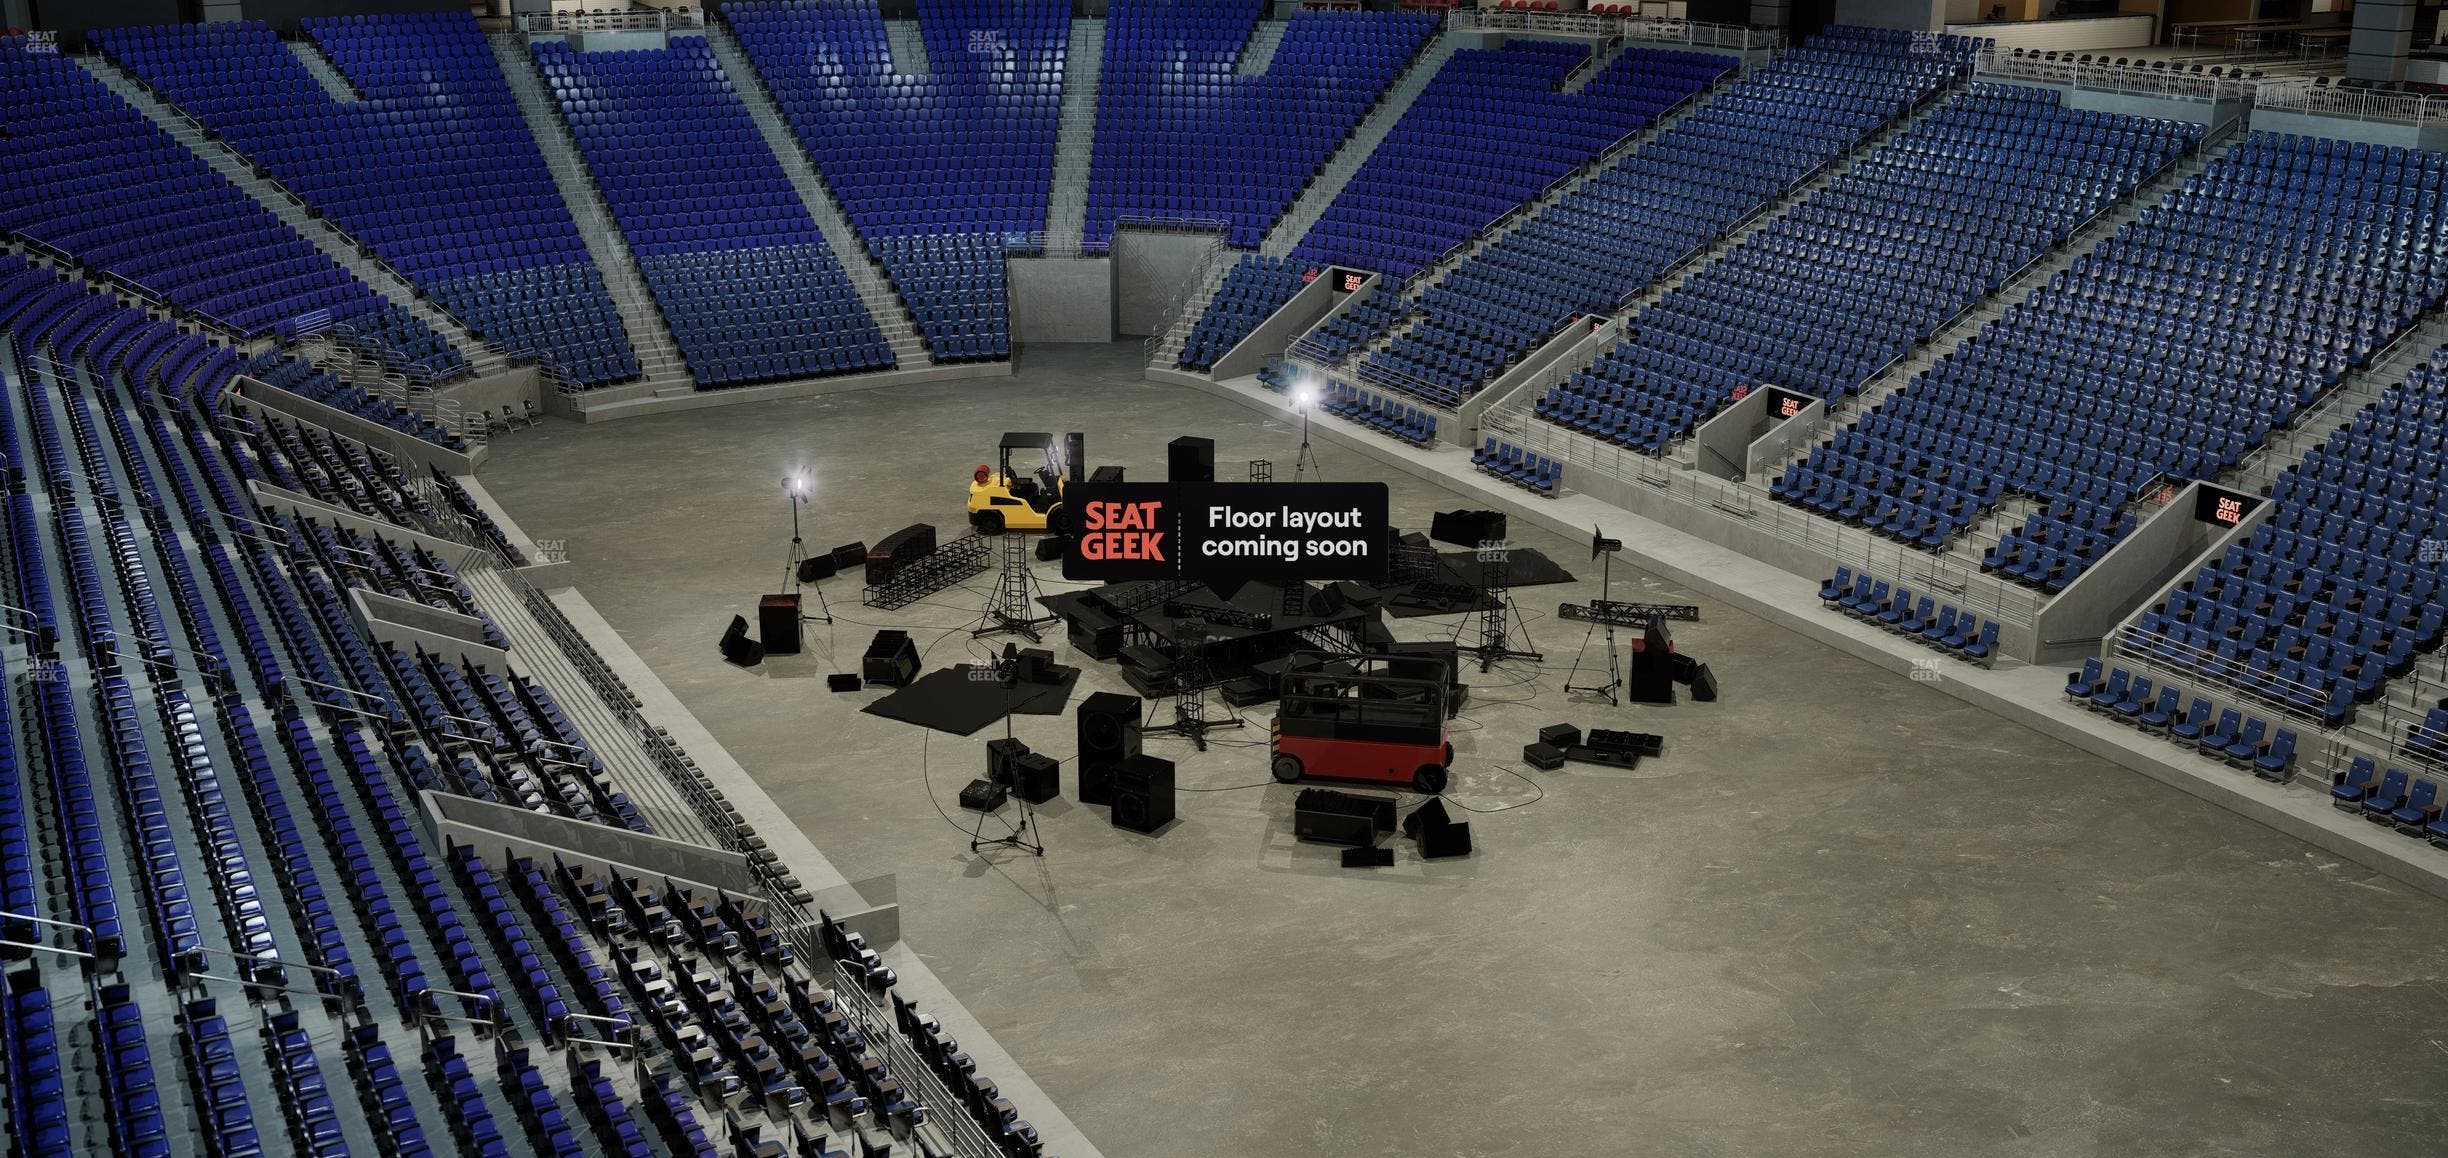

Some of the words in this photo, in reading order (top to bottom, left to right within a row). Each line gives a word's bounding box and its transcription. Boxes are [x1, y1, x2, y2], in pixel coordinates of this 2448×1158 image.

[1345, 274, 1362, 285] SEAT
[1782, 397, 1800, 409] SEAT
[2218, 497, 2242, 513] SEAT
[2216, 509, 2241, 525] GEEK
